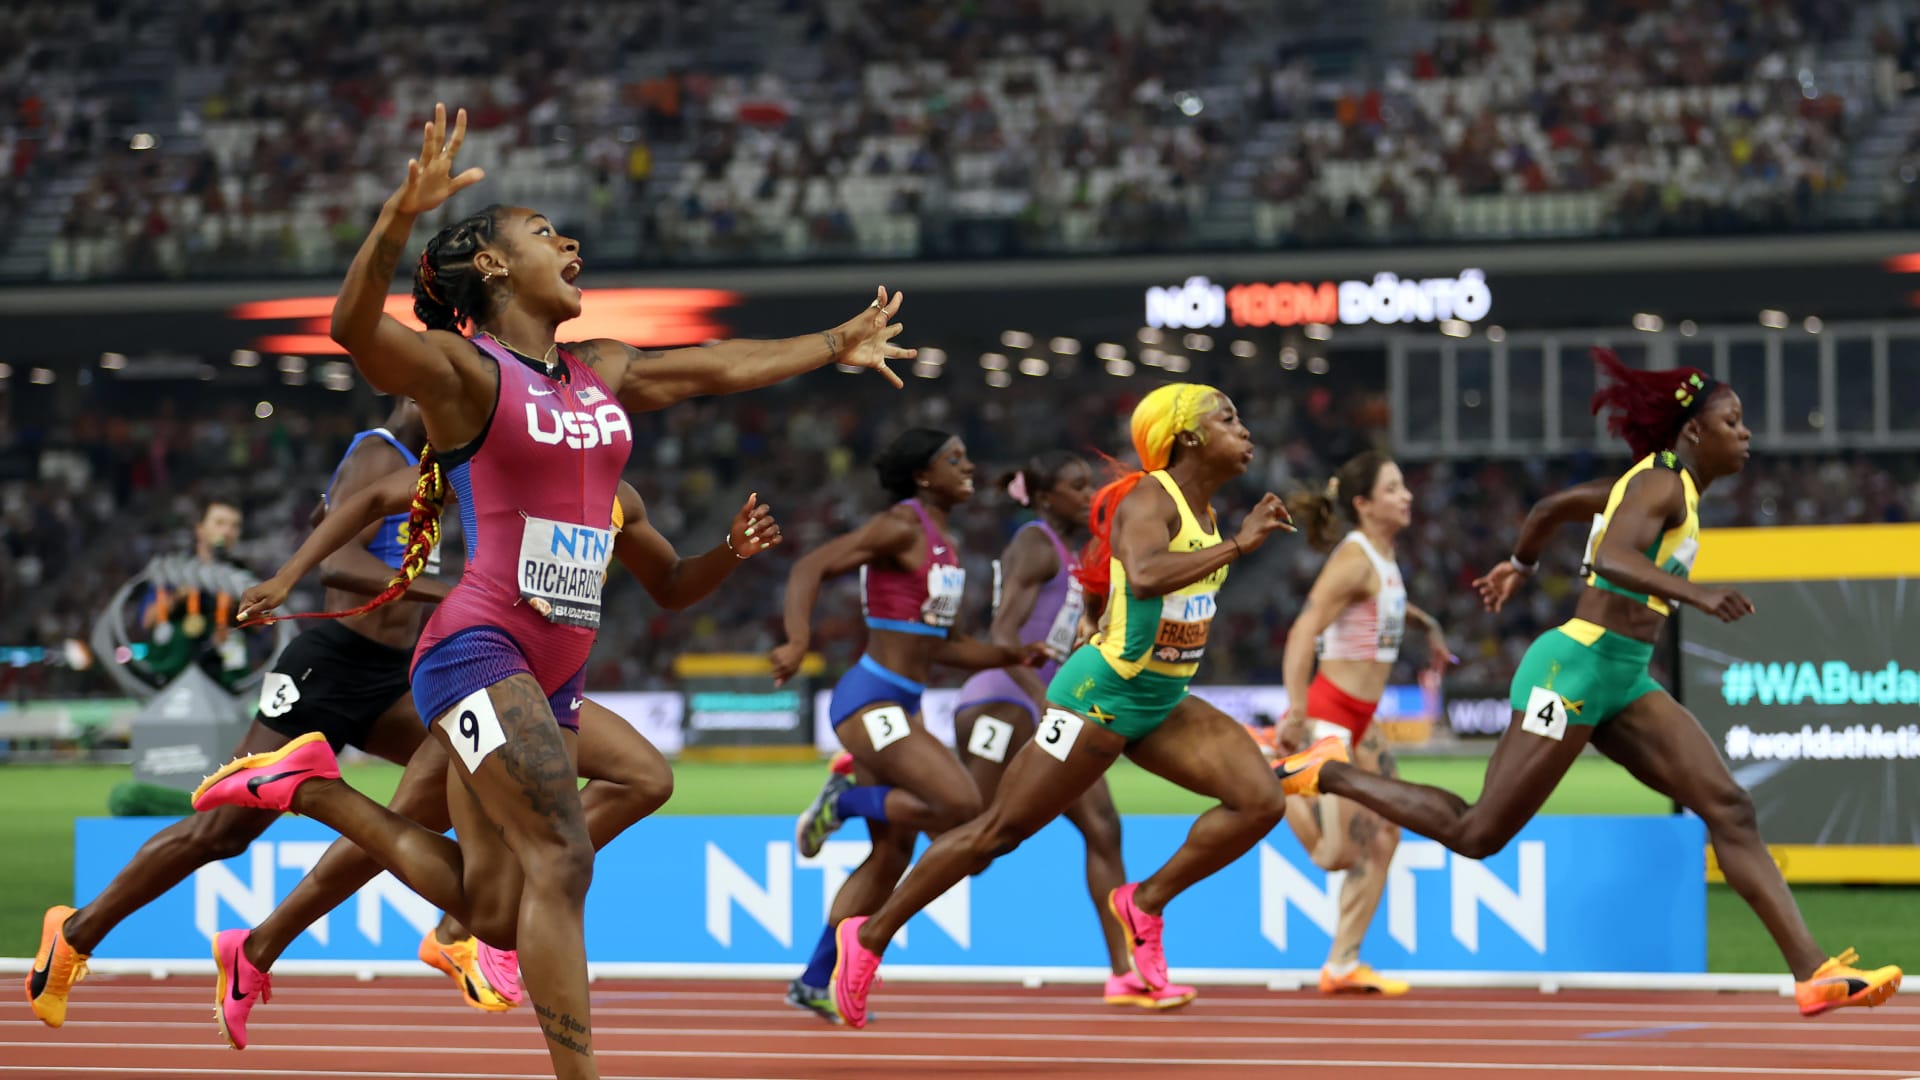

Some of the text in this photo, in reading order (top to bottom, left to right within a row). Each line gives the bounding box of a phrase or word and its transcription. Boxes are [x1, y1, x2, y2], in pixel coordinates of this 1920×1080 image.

[525, 402, 632, 449] USA
[551, 524, 609, 562] NTN
[1721, 660, 1920, 706] #WABuda
[459, 710, 480, 752] 9
[878, 705, 892, 737] 3
[1045, 718, 1066, 744] 5
[1537, 700, 1555, 727] 4
[982, 726, 996, 750] 2
[1260, 841, 1546, 954] NTN
